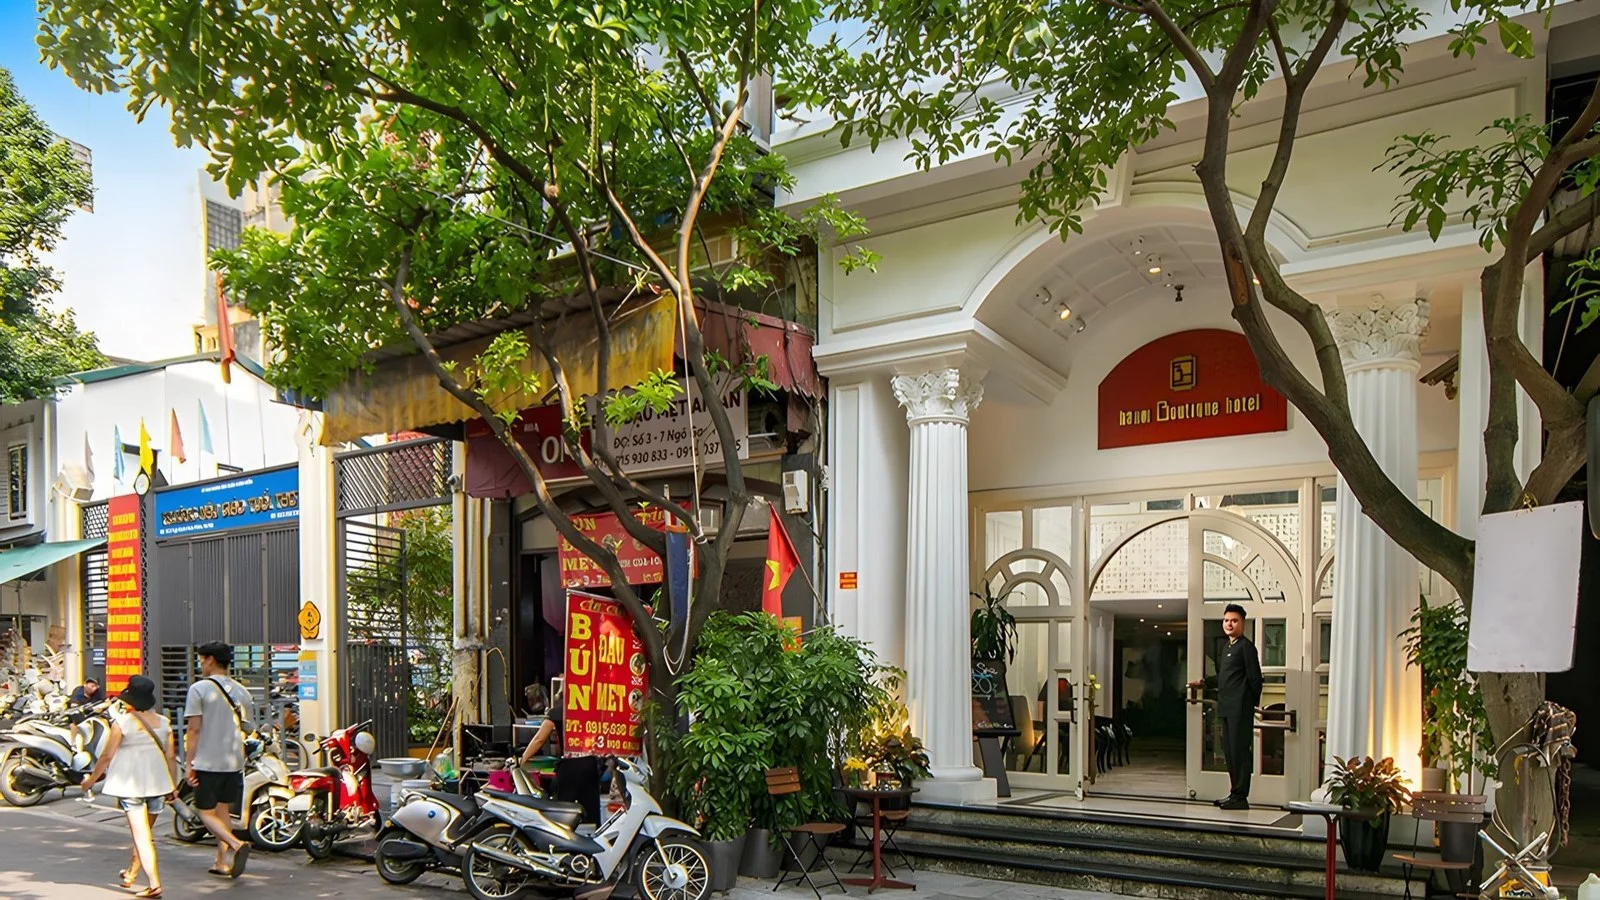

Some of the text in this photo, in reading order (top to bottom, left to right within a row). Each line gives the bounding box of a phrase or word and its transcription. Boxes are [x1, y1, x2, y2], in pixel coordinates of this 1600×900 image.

[1156, 400, 1219, 422] Boutique
[1226, 393, 1260, 414] hotel
[632, 452, 649, 464] 930
